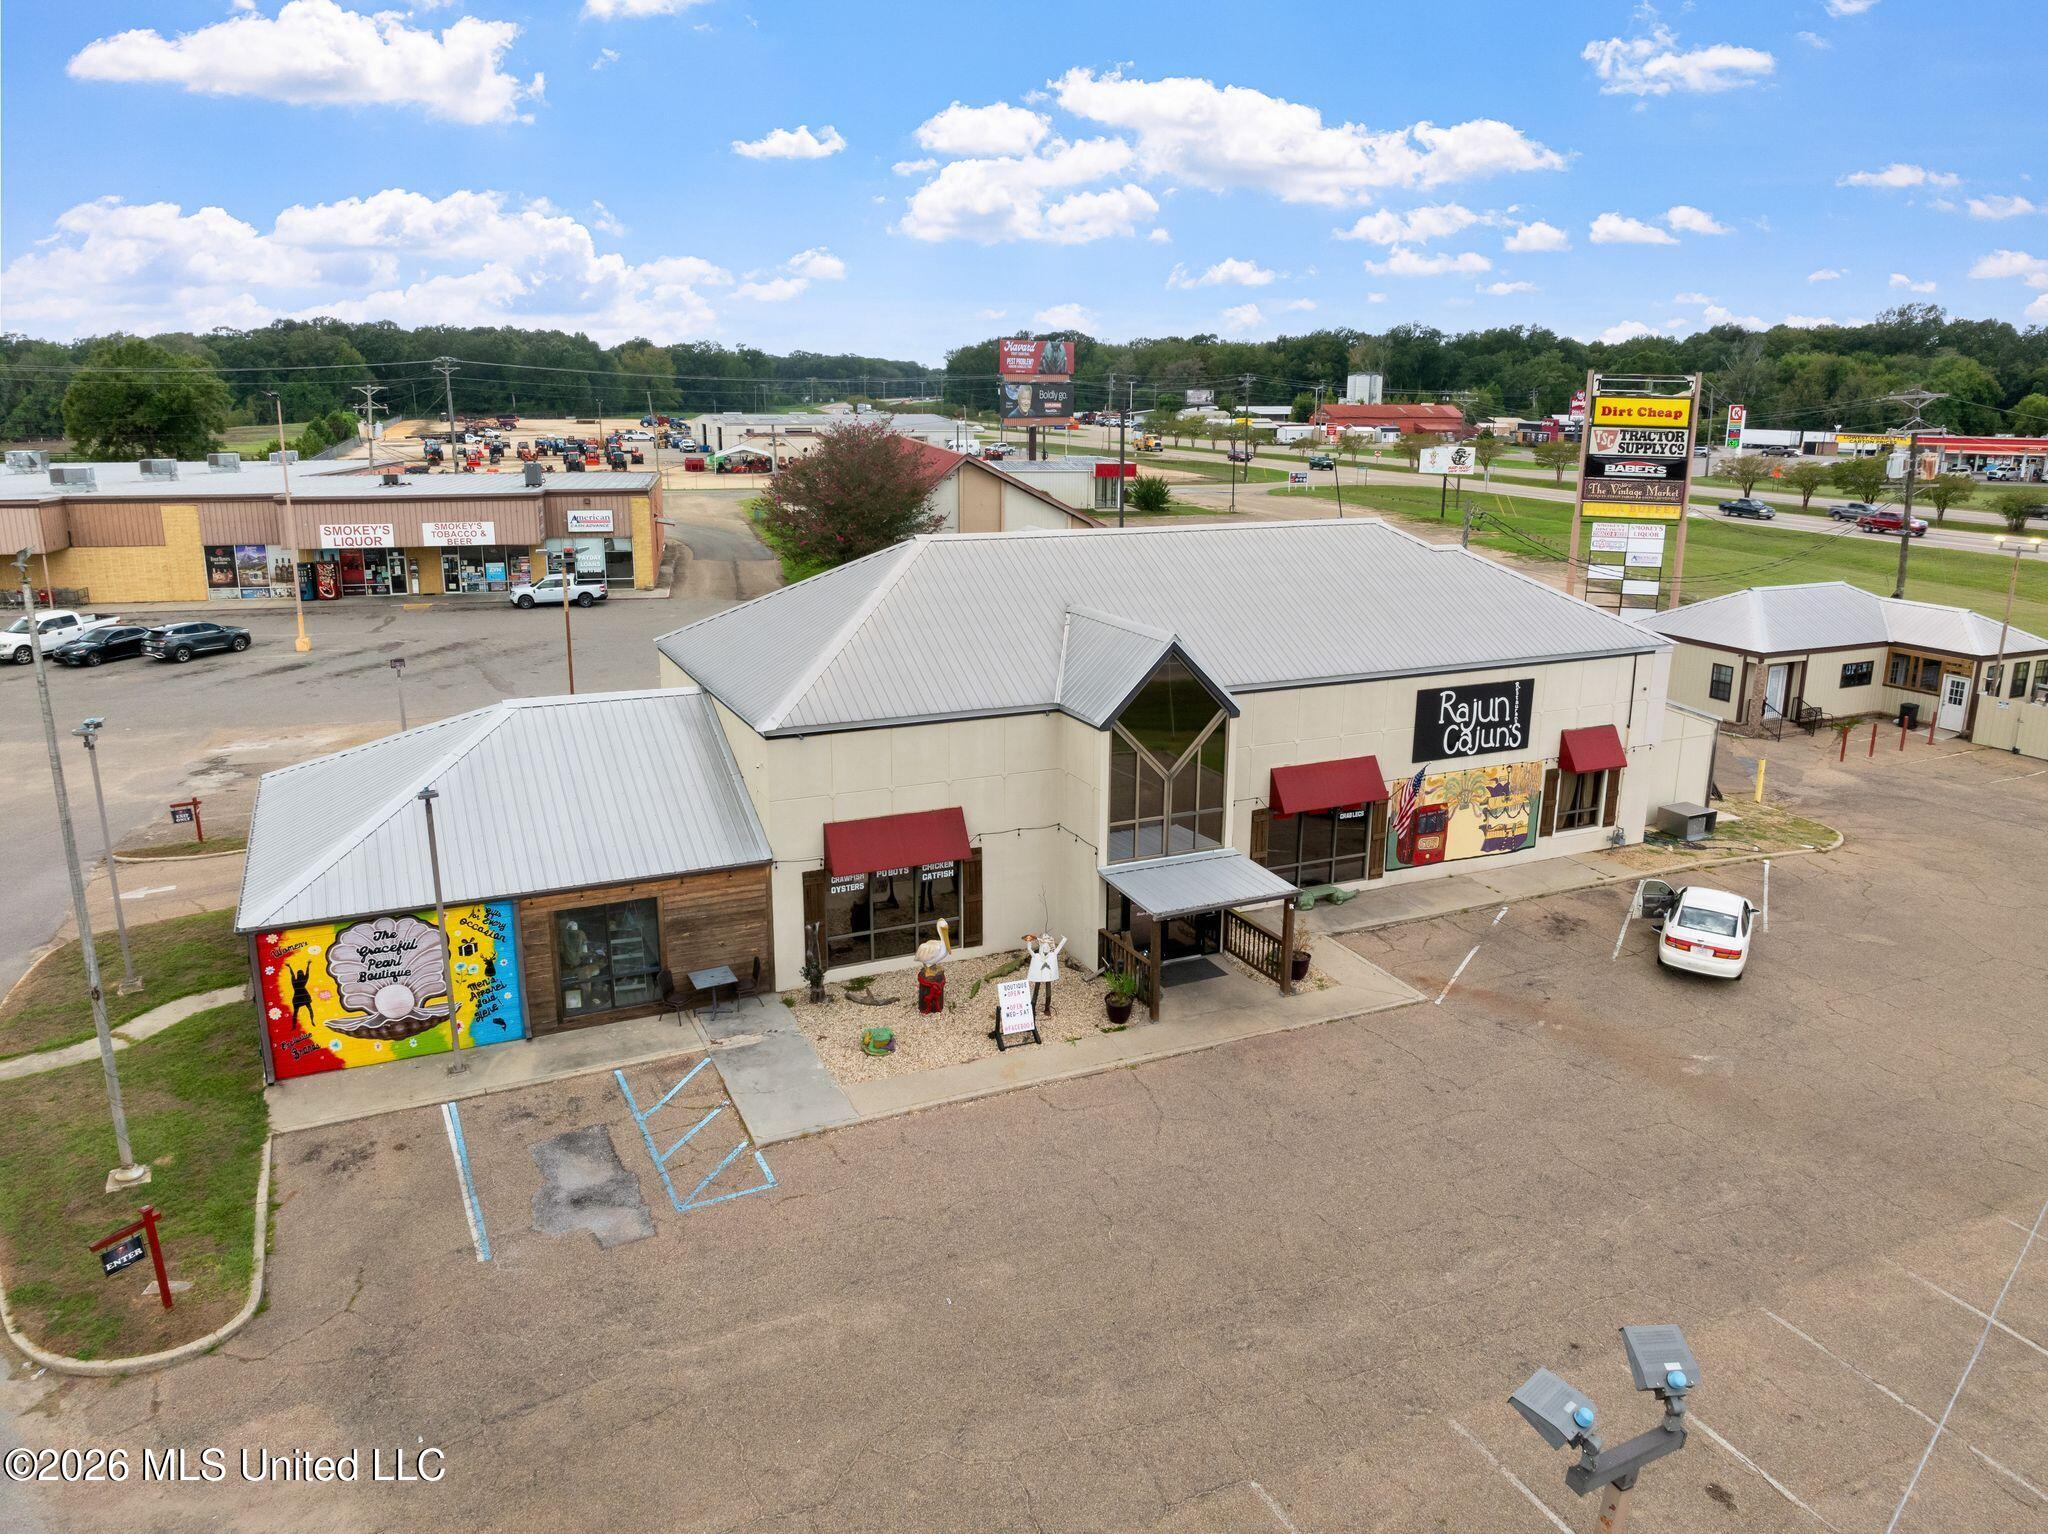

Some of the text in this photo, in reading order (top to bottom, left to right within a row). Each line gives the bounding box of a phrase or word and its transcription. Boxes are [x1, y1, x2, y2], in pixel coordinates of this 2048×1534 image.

[1039, 390, 1057, 401] Boldly
[1600, 406, 1683, 420] Dirt Cheap
[1595, 431, 1614, 448] TSC
[1619, 430, 1685, 442] TRACTOR
[1617, 442, 1667, 454] SUPPLY
[1604, 464, 1667, 474] BABER'S
[1588, 482, 1606, 495] The
[1610, 483, 1643, 499] Vintage
[1646, 484, 1679, 498] Market
[570, 514, 610, 523] American
[324, 525, 391, 536] SMOKEY'S
[434, 523, 483, 531] SMOKEY'S
[431, 530, 478, 538] TOBACCO
[333, 536, 384, 547] LIQUOR
[447, 538, 473, 546] BEER
[1438, 690, 1511, 733] Rajun
[1443, 723, 1522, 755] Cajun's
[1339, 810, 1364, 820] CRAB LEGS
[922, 860, 954, 871] CHICKEN
[831, 873, 865, 884] CRAWFISH
[922, 870, 954, 881] CATFISH
[831, 882, 865, 894] OYSTERS
[373, 930, 398, 941] The
[459, 918, 506, 943] Occasion
[356, 938, 418, 963] Graceful
[367, 955, 403, 971] Pearl
[357, 969, 411, 983] Boutique
[105, 1247, 143, 1271] ENTER
